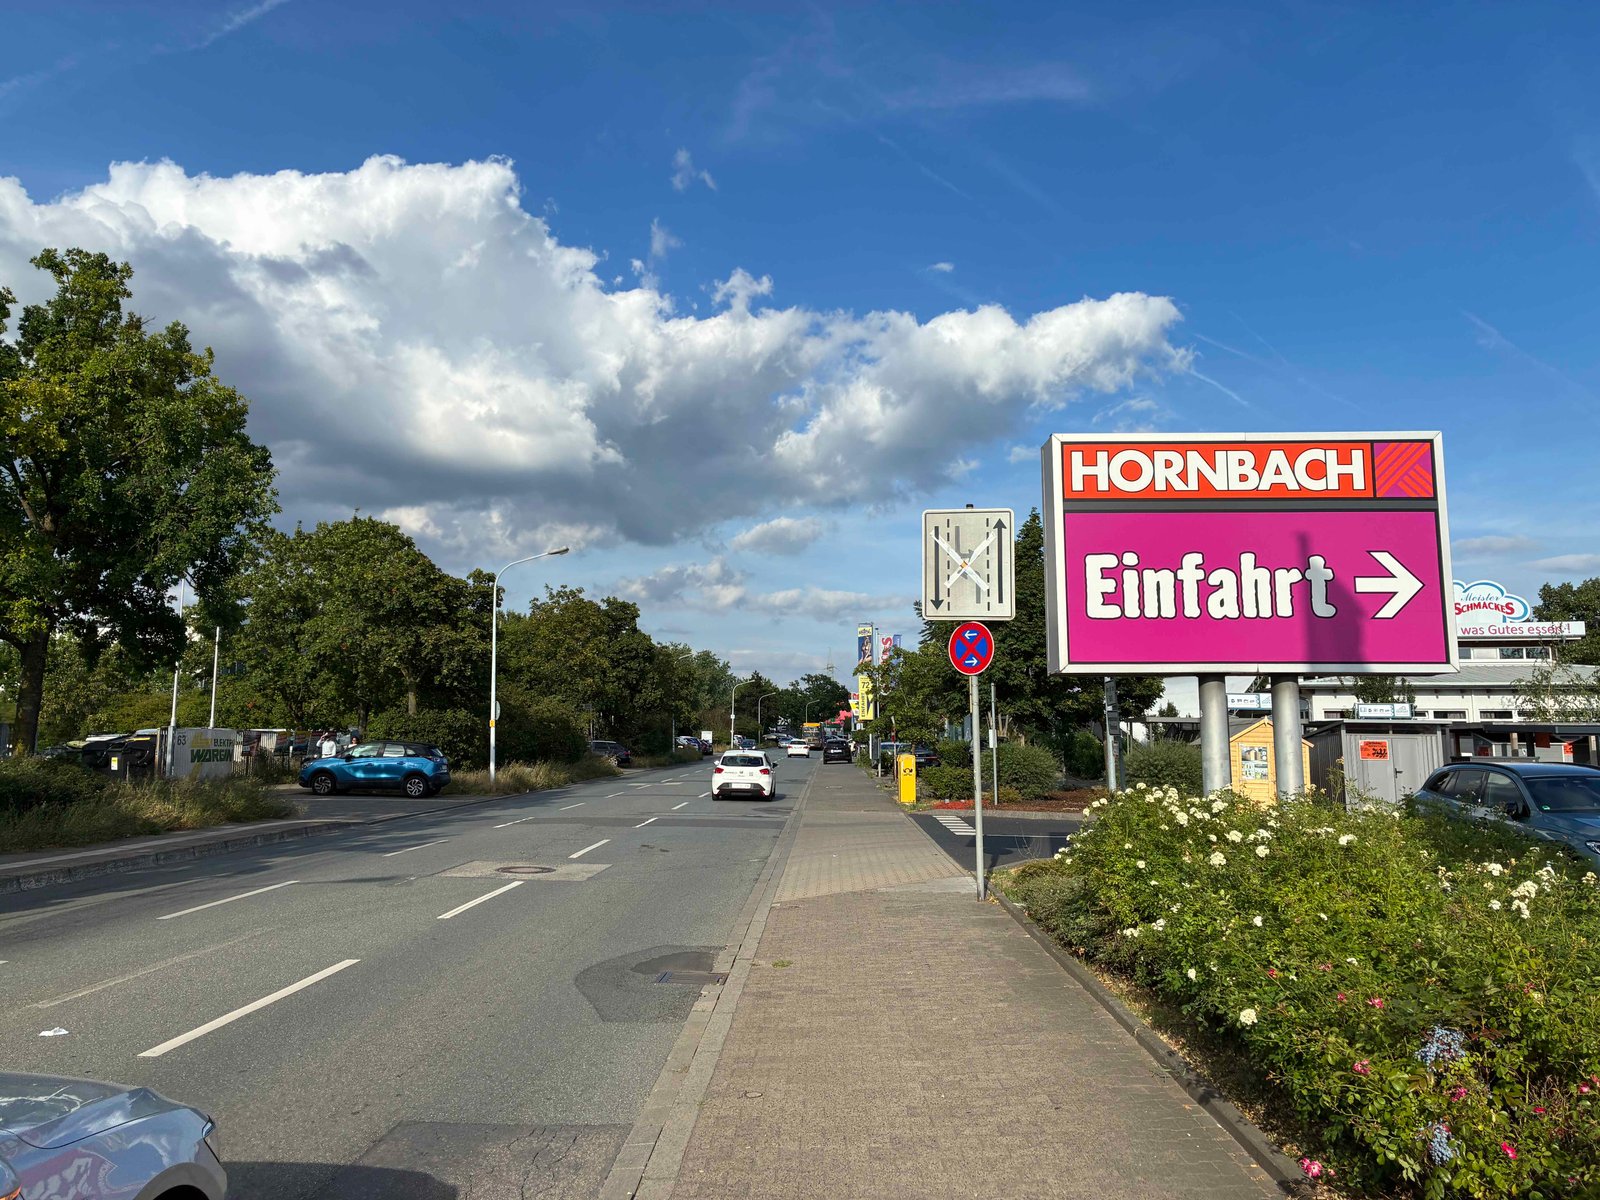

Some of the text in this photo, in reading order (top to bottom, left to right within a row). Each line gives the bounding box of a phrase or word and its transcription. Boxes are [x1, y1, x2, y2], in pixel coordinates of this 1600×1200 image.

[1071, 448, 1366, 492] HORNBACH
[1084, 551, 1337, 620] Einfahrt
[1460, 592, 1501, 602] Meister
[1454, 601, 1515, 615] SCHMACKES
[1461, 627, 1484, 635] was
[1488, 624, 1524, 635] Gutes
[177, 735, 187, 746] 63
